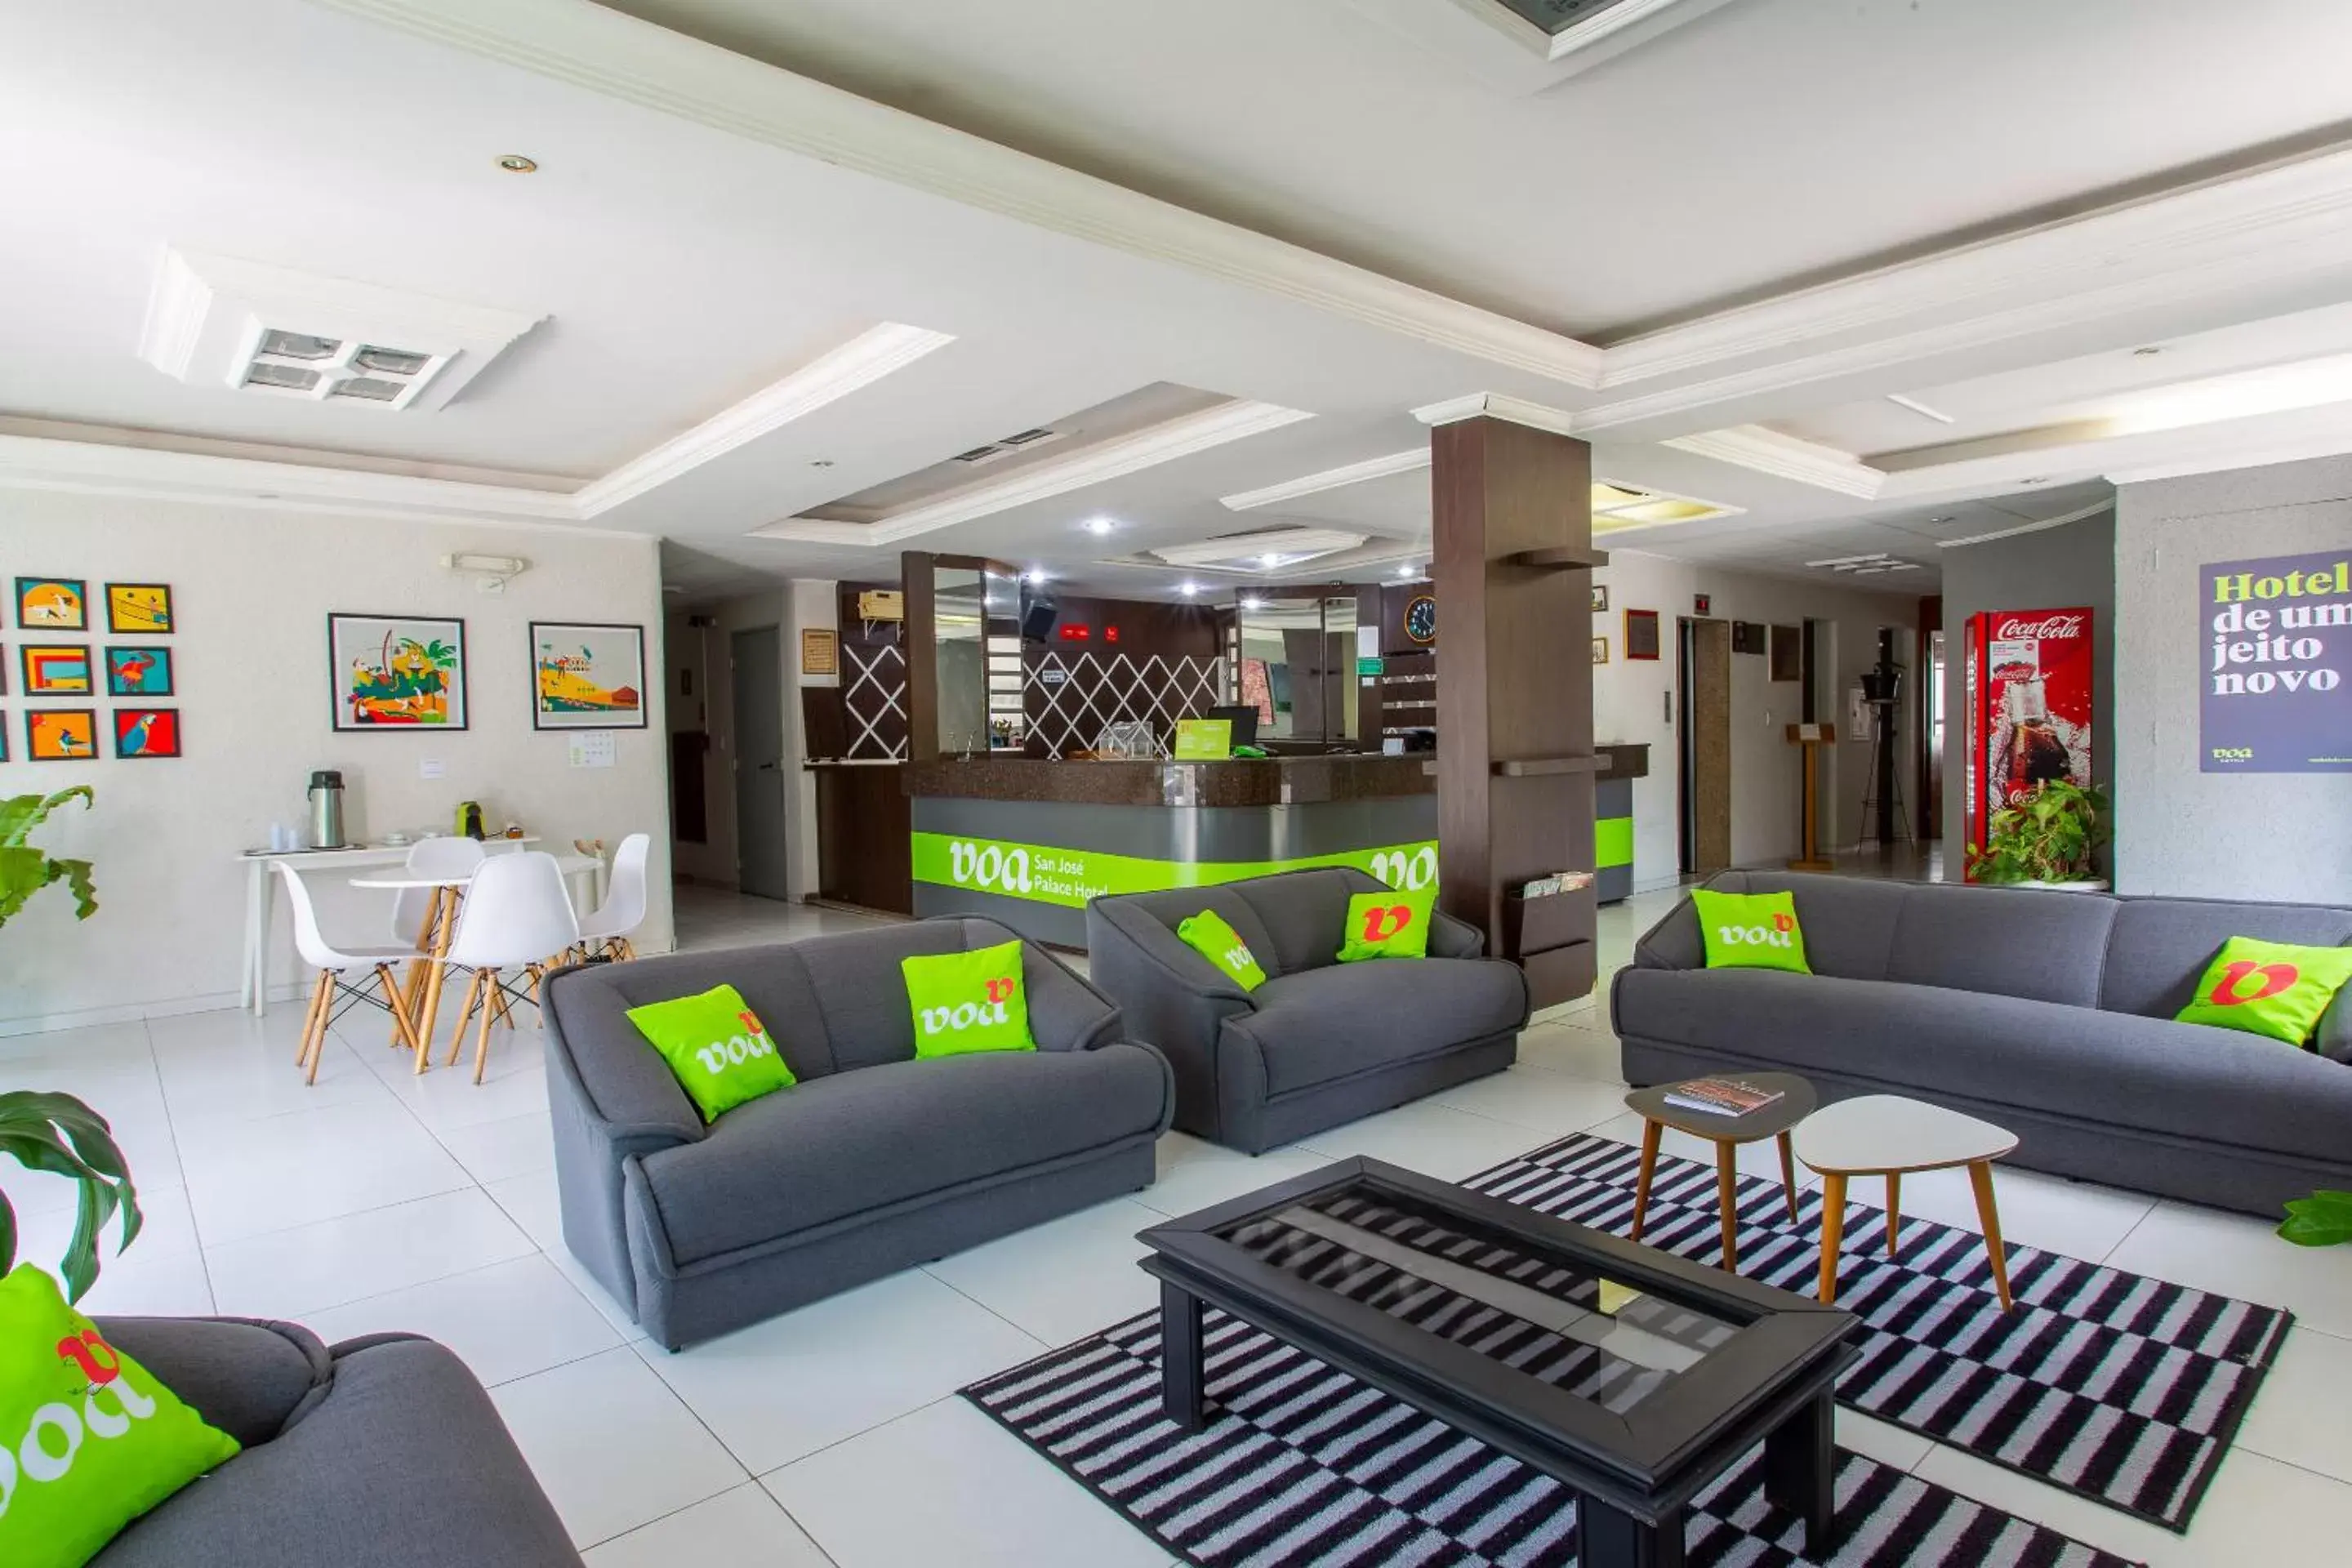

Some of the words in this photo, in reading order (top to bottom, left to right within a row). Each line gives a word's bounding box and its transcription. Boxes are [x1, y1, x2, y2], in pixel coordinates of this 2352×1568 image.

[2213, 562, 2350, 603] Hotel
[2213, 603, 2271, 633] de
[2279, 603, 2352, 629] um
[2212, 631, 2323, 671] jeito
[2213, 669, 2340, 695] novo
[950, 841, 1032, 893] voa
[1034, 854, 1055, 871] San
[1058, 857, 1085, 875] José
[1370, 846, 1440, 892] vo
[1034, 875, 1072, 897] Palace
